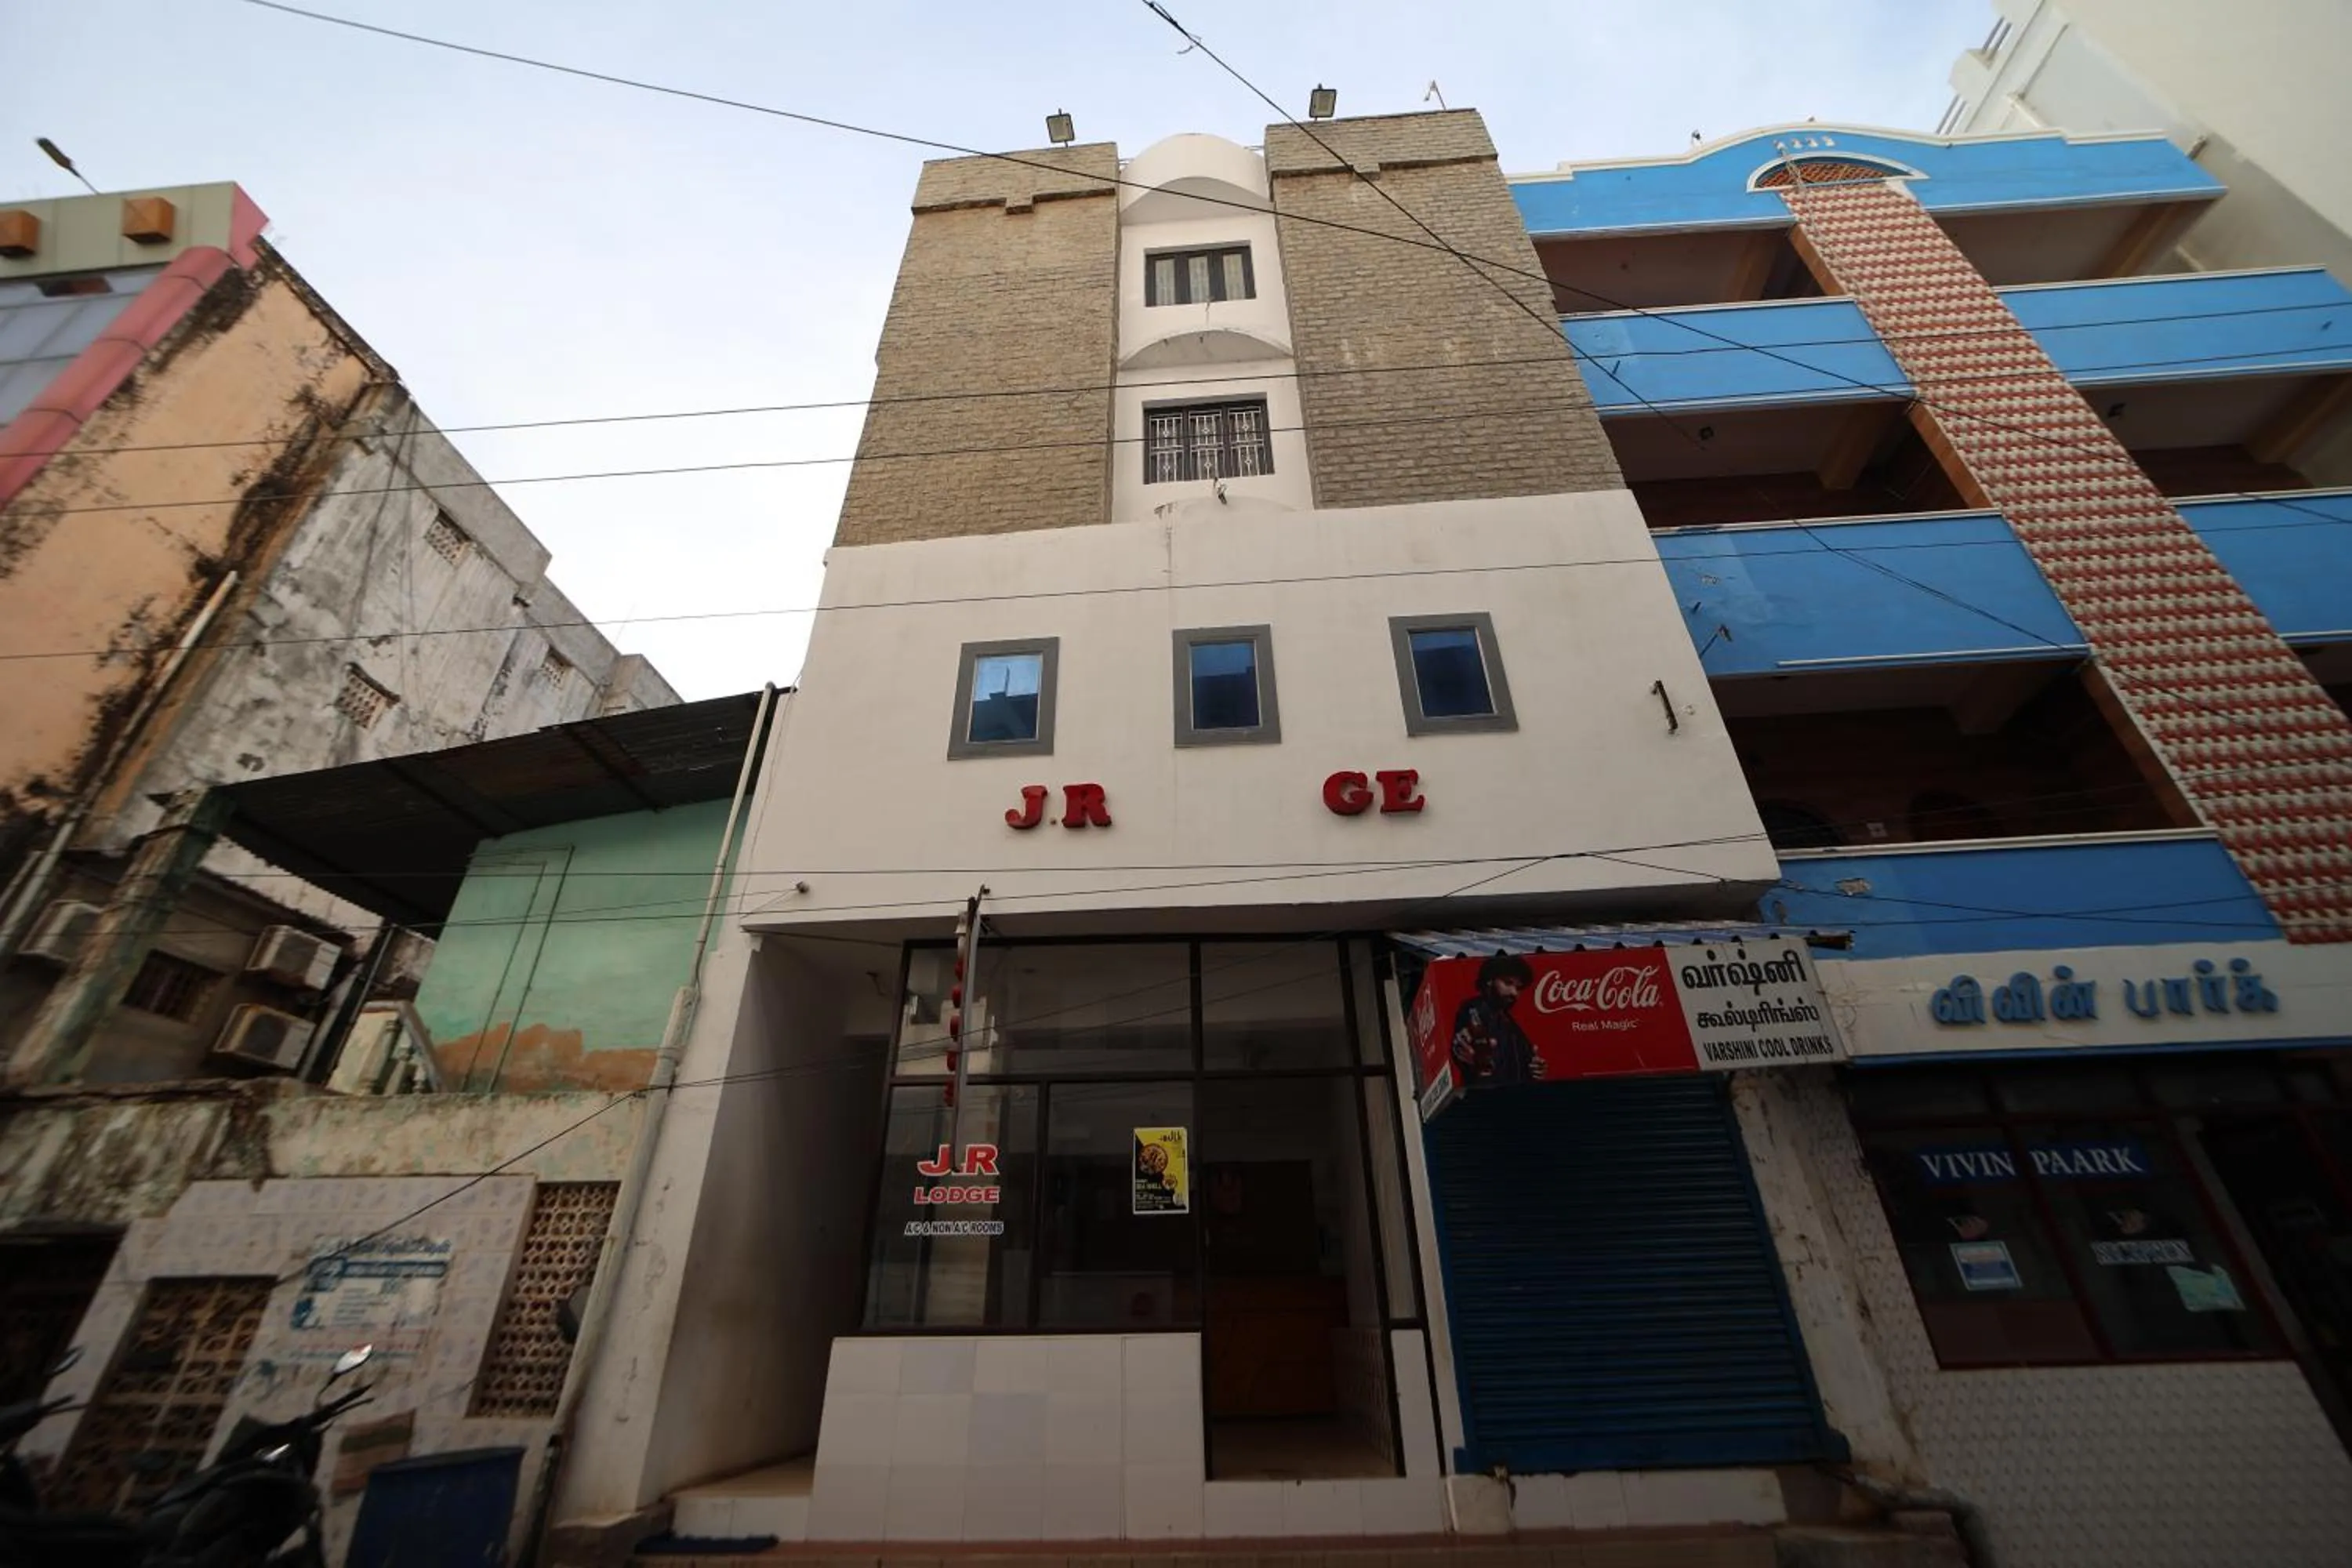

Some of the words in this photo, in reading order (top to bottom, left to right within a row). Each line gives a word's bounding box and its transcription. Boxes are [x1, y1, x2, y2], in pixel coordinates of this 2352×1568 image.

[1004, 783, 1112, 829] J.R
[1323, 769, 1425, 816] GE
[1534, 965, 1660, 1013] Coca-Cola
[1930, 964, 2100, 1025] விவின்
[2122, 957, 2280, 1018] பார்க்
[1571, 1022, 1599, 1032] Real
[1602, 1018, 1639, 1032] Magic
[1703, 1040, 1759, 1062] VARSHINI
[1758, 1037, 1791, 1058] COOL
[1789, 1034, 1834, 1055] DRINKS
[1919, 1149, 2018, 1179] VIVIN
[2029, 1145, 2146, 1176] PAARK
[913, 1186, 1000, 1204] LODGE
[931, 1220, 952, 1235] NON
[970, 1220, 1004, 1235] ROOMS
